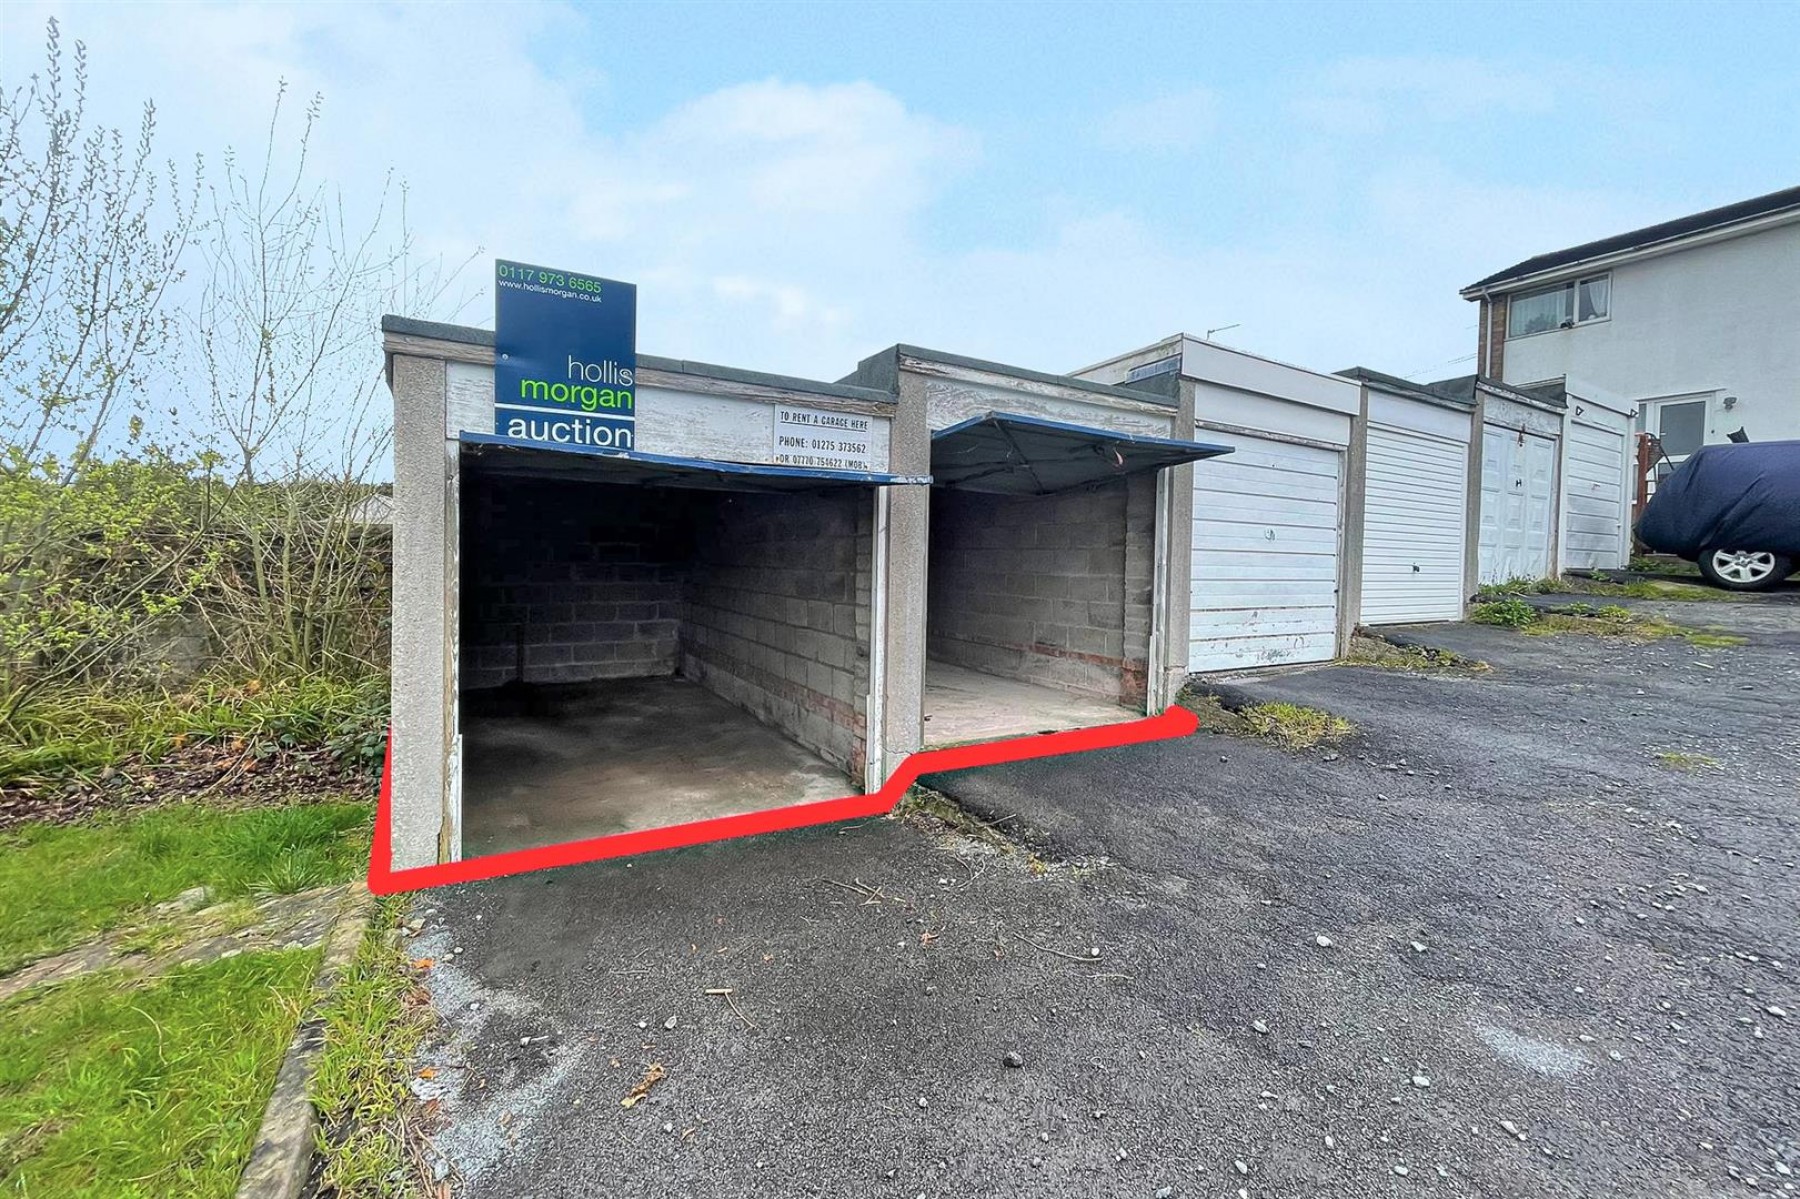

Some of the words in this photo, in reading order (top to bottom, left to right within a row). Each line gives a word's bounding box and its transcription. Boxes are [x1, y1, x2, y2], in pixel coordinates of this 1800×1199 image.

[499, 264, 534, 281] 0117
[538, 271, 565, 287] 973
[568, 277, 602, 293] 6565
[499, 279, 602, 303] www.hollismorgan.co.uk
[568, 354, 633, 387] hollis
[521, 379, 632, 411] morgan
[507, 417, 632, 448] auction
[781, 411, 789, 421] TO
[792, 413, 810, 423] RENT
[813, 415, 818, 424] A
[821, 416, 848, 428] GARAGE
[851, 421, 868, 430] HERE
[779, 435, 808, 448] PHONE:
[811, 439, 835, 451] 01275
[838, 442, 866, 454] 373562
